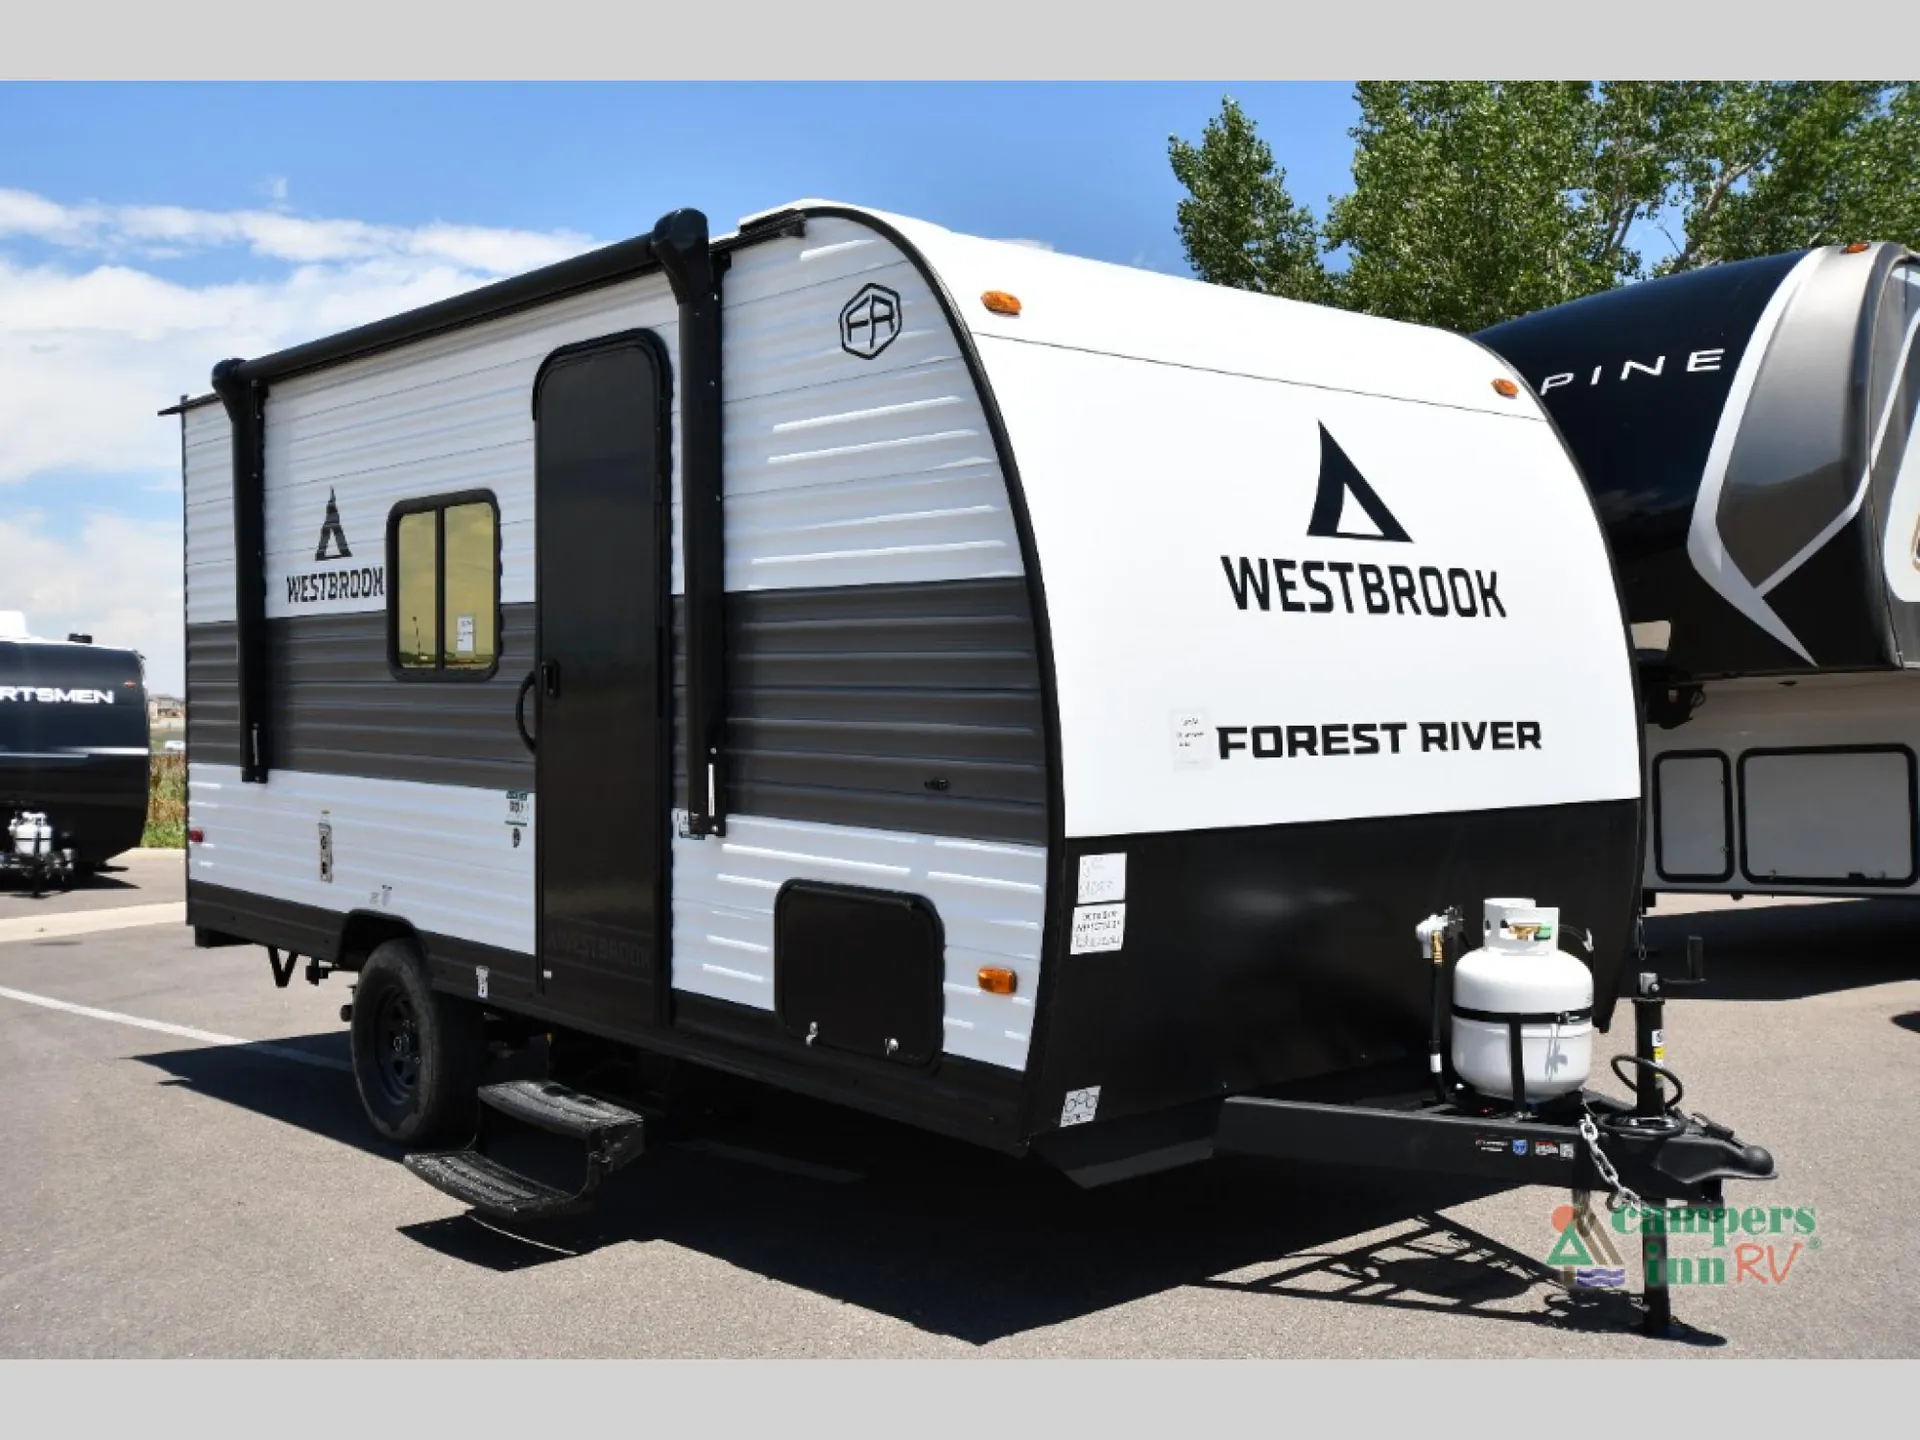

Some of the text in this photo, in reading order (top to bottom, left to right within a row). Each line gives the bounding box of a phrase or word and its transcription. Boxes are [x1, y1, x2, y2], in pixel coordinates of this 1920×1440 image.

[1540, 348, 1725, 396] PINE
[286, 567, 384, 603] WESTBROOK
[1220, 555, 1507, 618] WESTBROOK
[0, 685, 115, 704] RTSMEN
[1216, 723, 1408, 760] FOREST
[1418, 721, 1542, 752] RIVER
